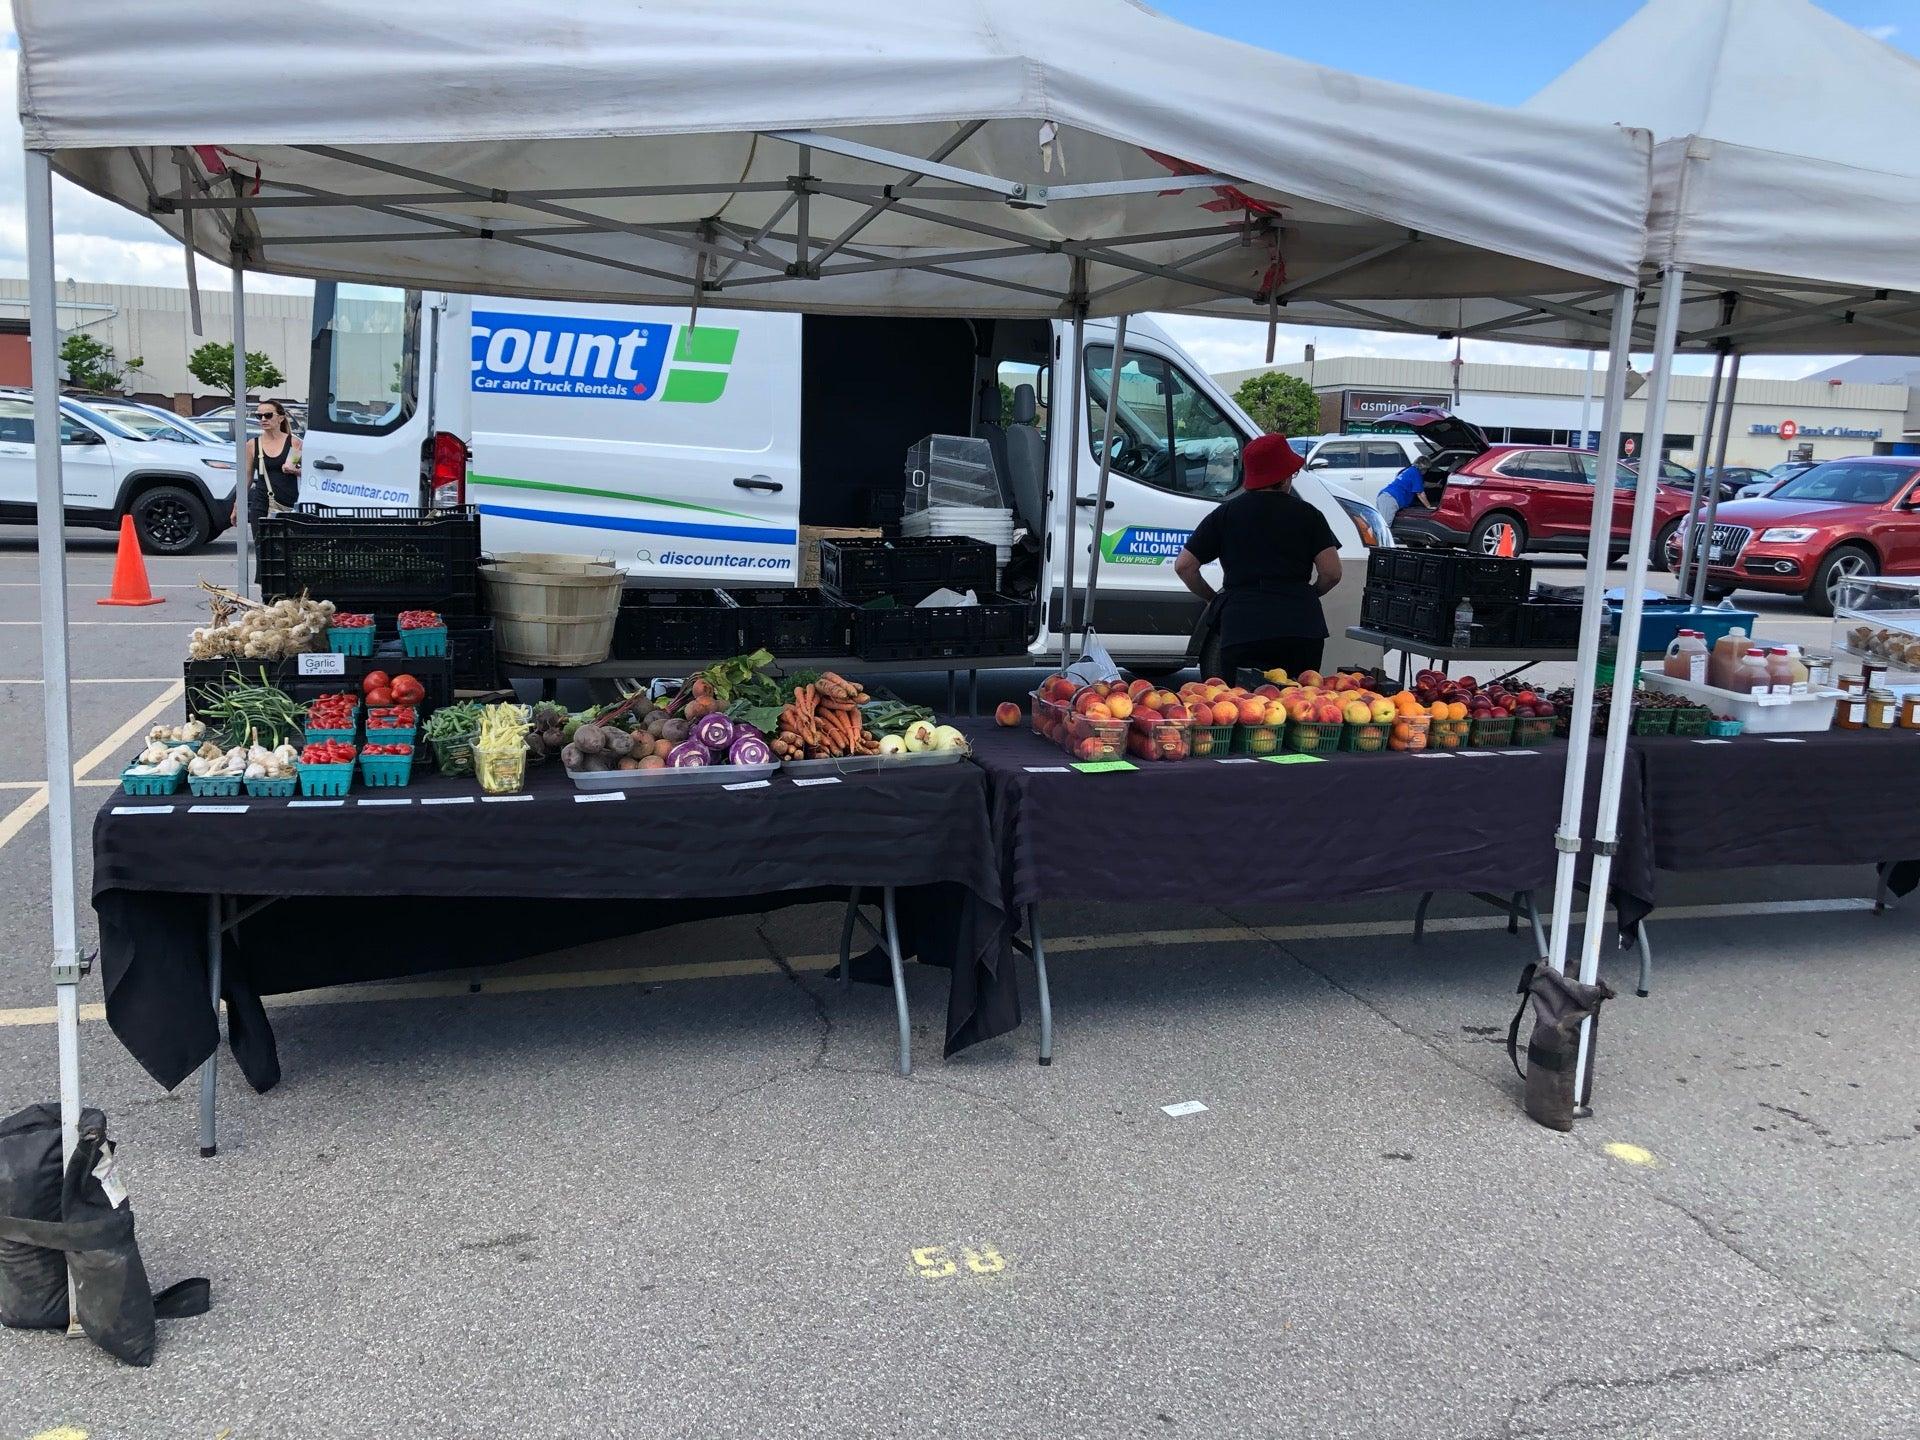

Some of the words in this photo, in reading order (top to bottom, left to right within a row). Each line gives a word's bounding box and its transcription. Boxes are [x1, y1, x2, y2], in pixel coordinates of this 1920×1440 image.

[474, 376, 500, 388] Car
[502, 378, 530, 391] and
[533, 379, 572, 393] Truck
[575, 382, 628, 396] Rentals
[1353, 399, 1407, 412] Jasmine
[321, 478, 410, 504] discountcar.com
[1135, 531, 1190, 544] UNLIMIT
[659, 551, 791, 569] discountcar.com
[1134, 556, 1158, 564] PRICE
[305, 658, 336, 668] Garlic
